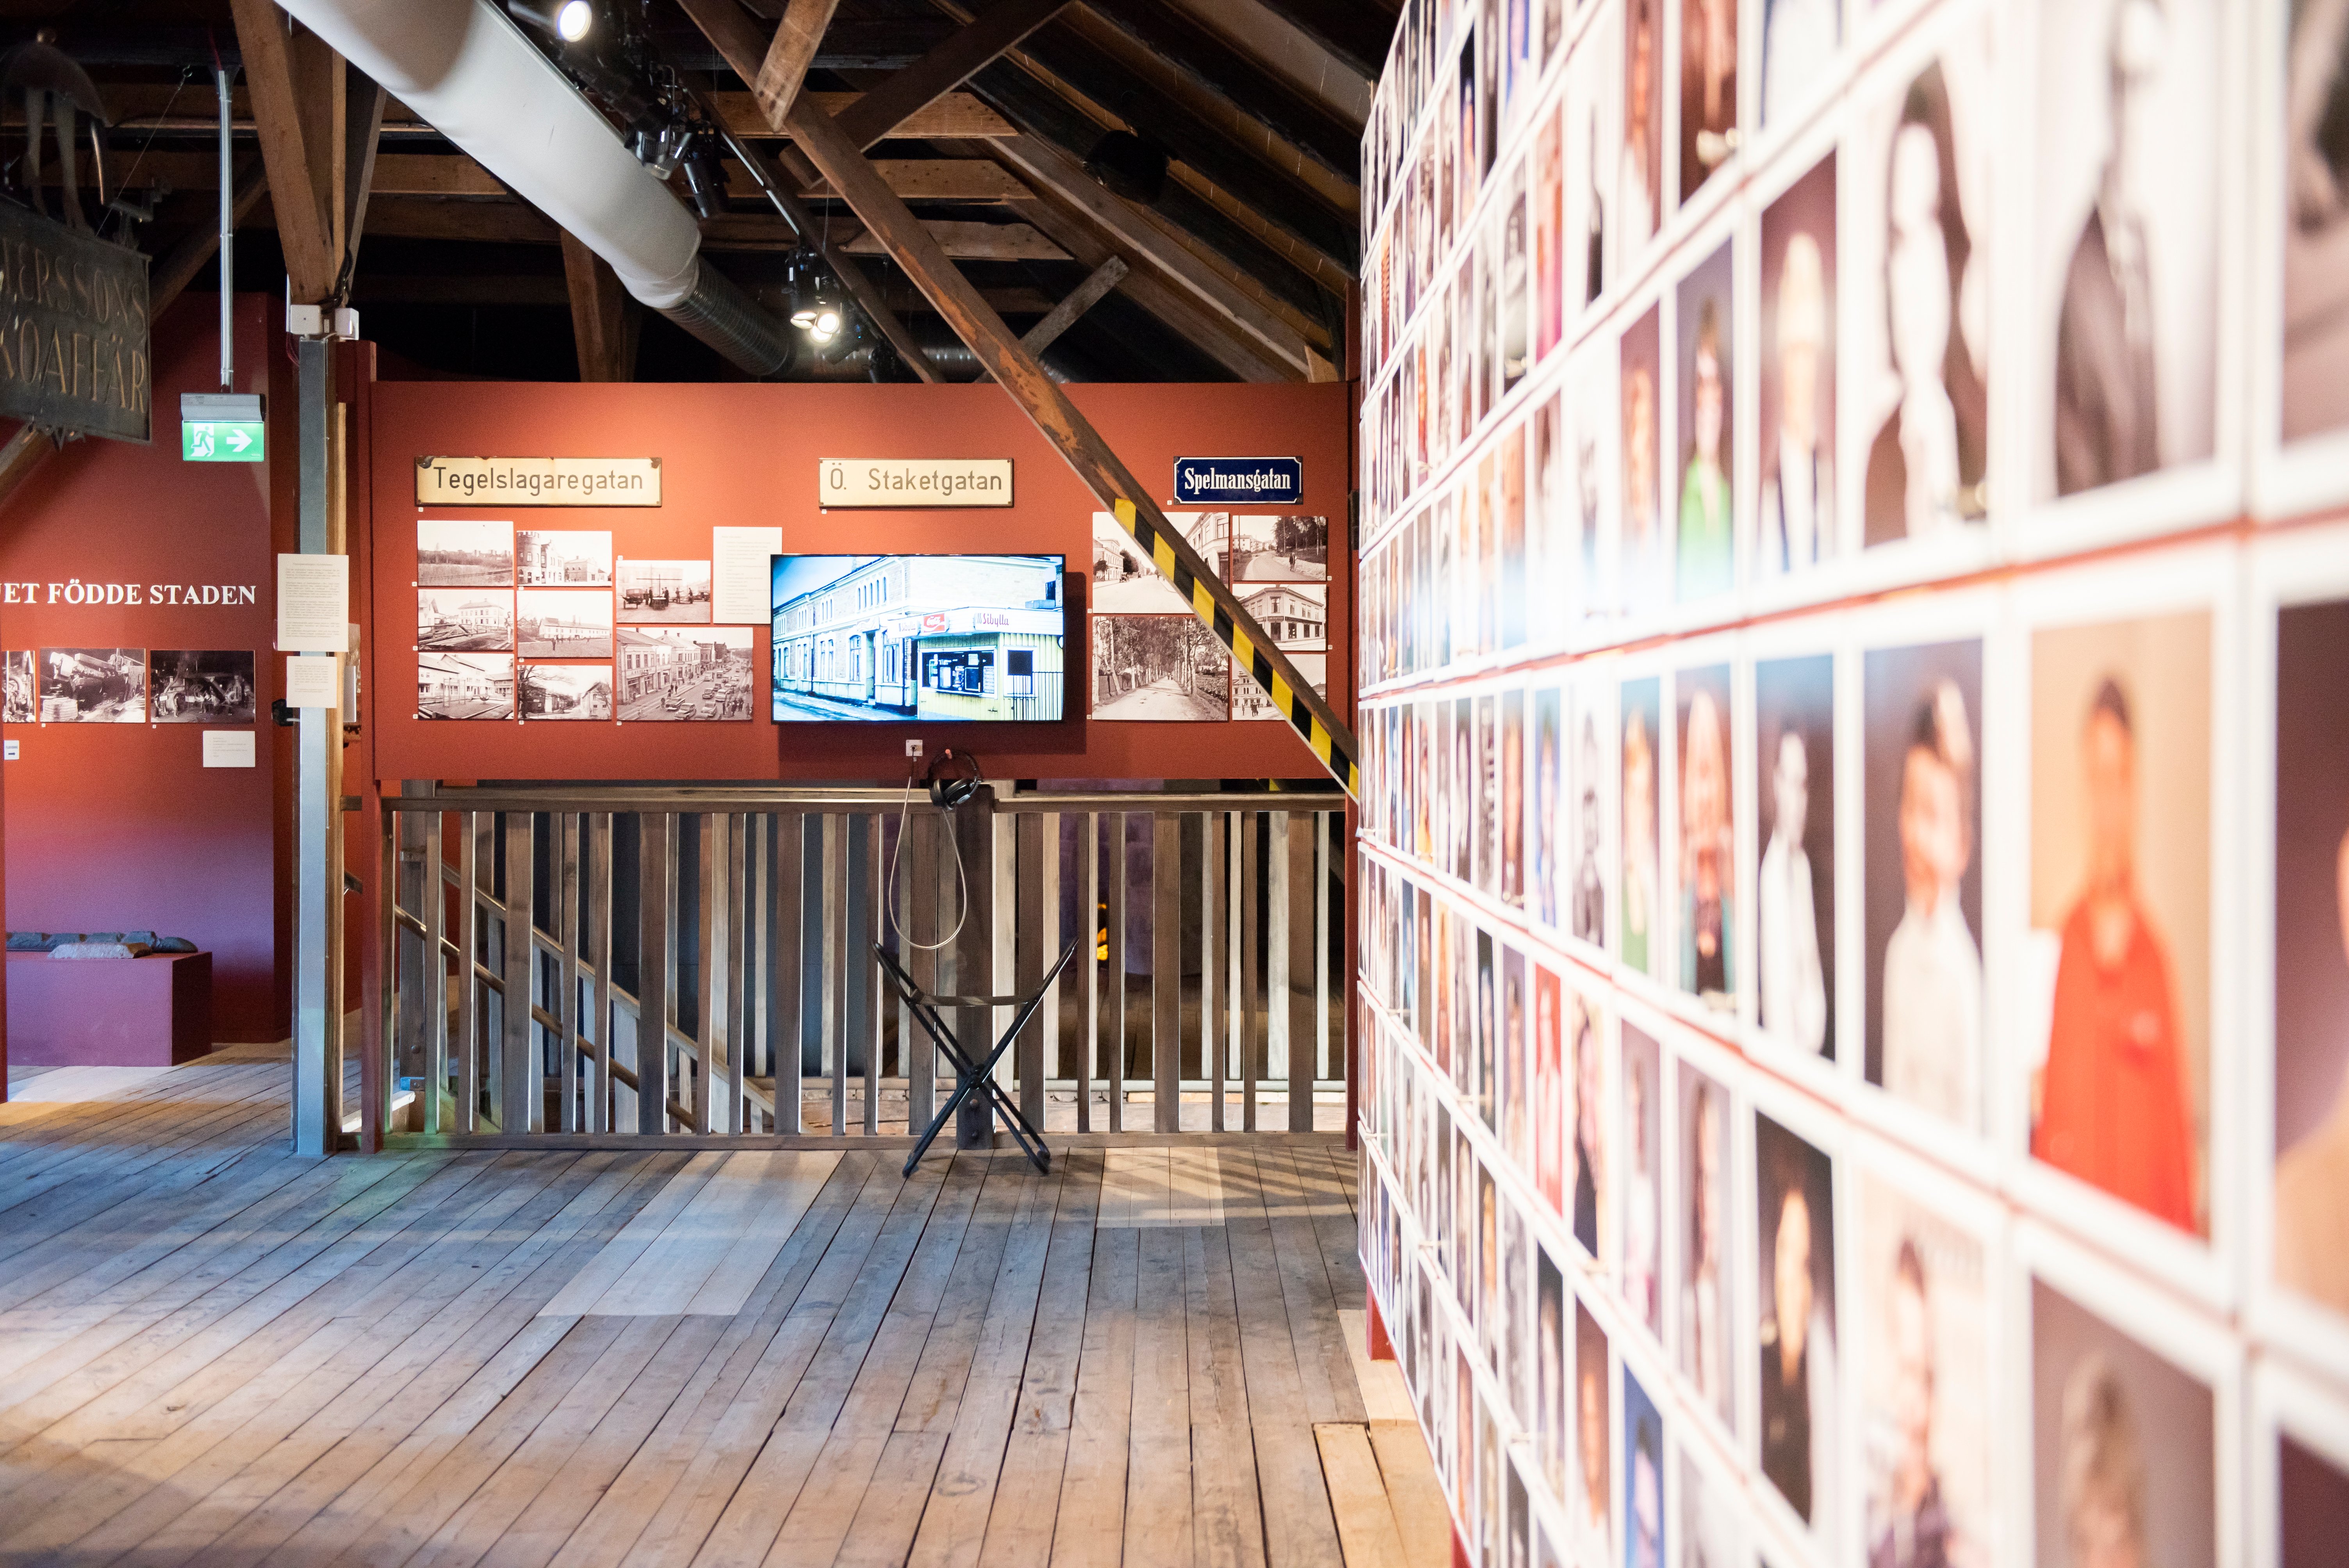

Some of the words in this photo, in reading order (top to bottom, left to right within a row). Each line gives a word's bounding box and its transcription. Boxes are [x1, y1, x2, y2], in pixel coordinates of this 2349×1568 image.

[433, 467, 642, 496] Tegelslagaregatan
[868, 468, 1002, 496] Staketgatan
[1185, 467, 1291, 494] Spelmansgatan
[0, 583, 39, 603] ET
[47, 579, 142, 604] FÖDDE
[150, 584, 256, 604] STADEN
[983, 613, 1009, 627] Sibylla
